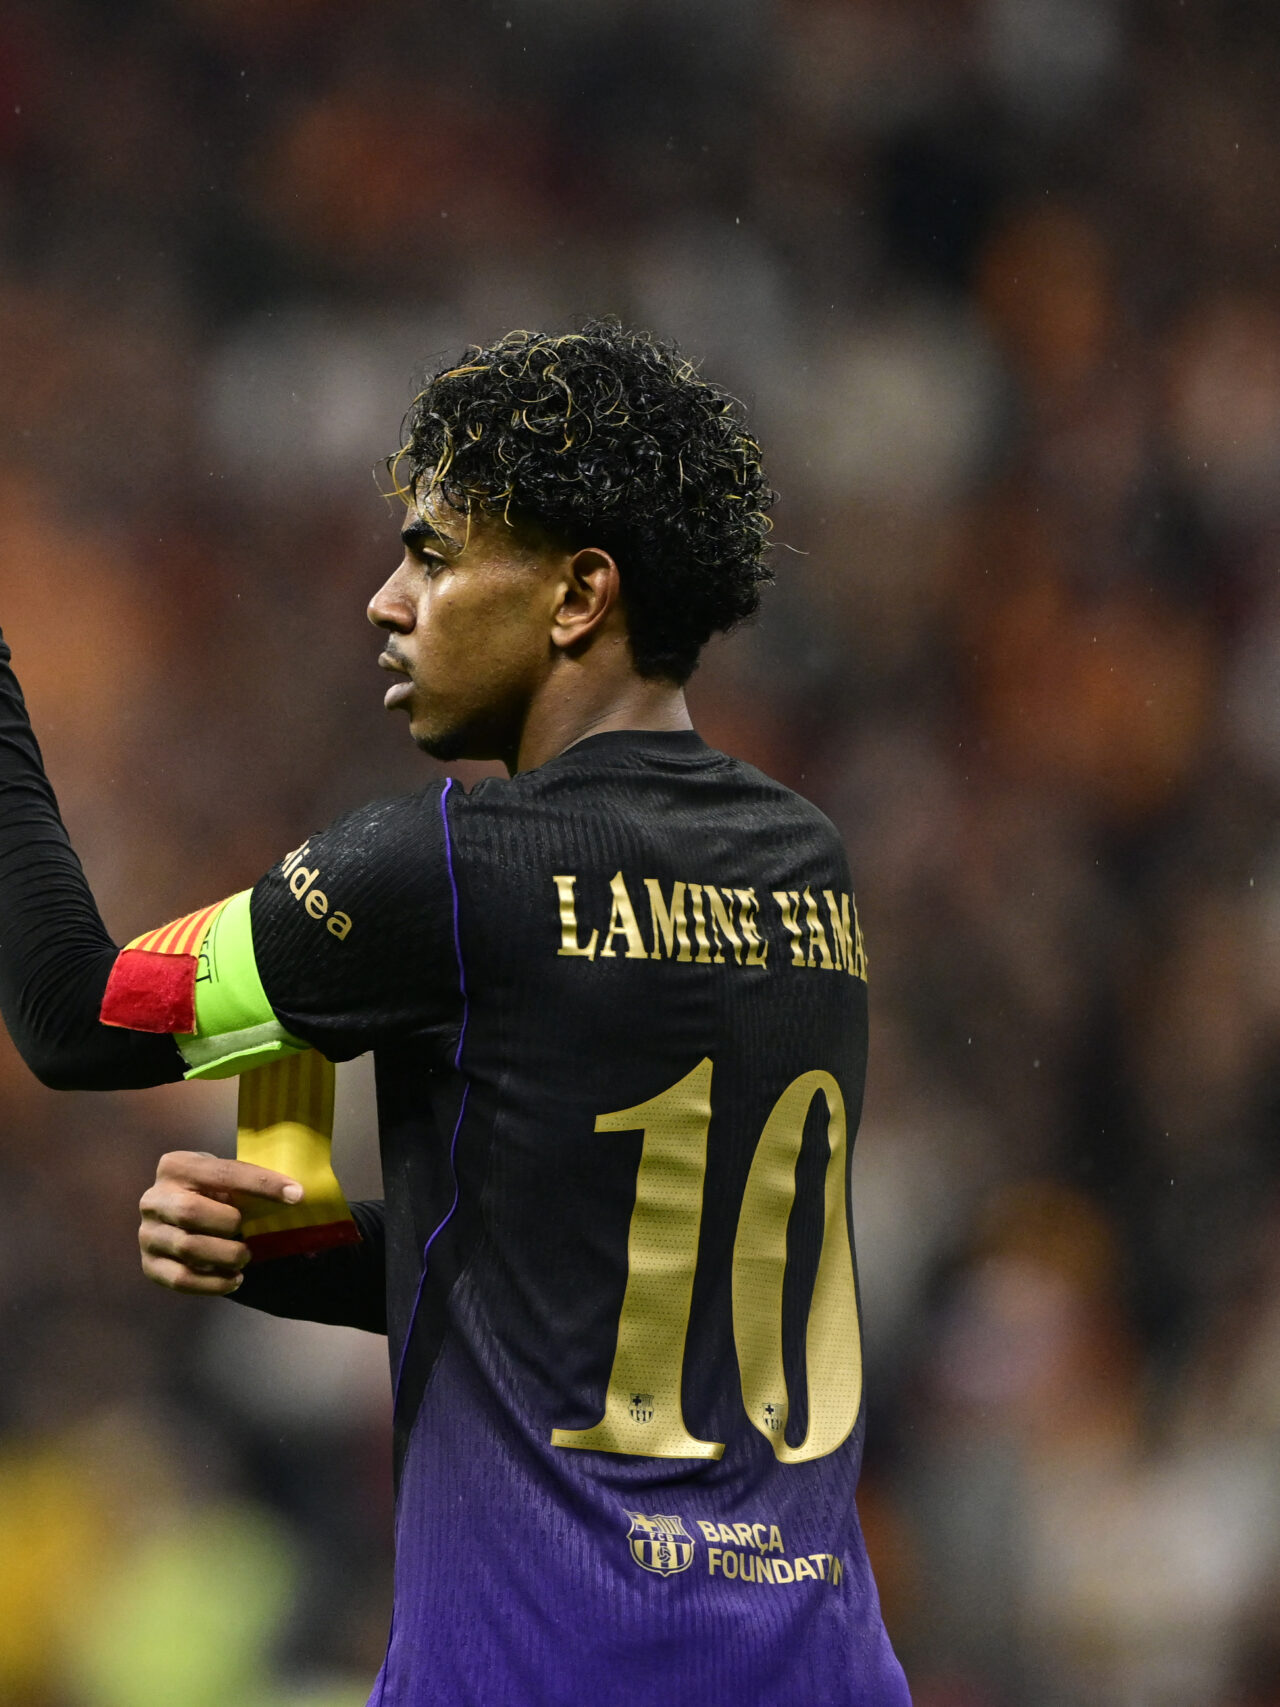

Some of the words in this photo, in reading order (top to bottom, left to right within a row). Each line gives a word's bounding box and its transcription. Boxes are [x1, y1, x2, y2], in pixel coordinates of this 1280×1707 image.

[281, 839, 352, 941] idea
[553, 871, 768, 969] LAMINE
[772, 885, 868, 983] YAMA
[551, 1057, 863, 1464] 10
[696, 1520, 785, 1555] BARÇA
